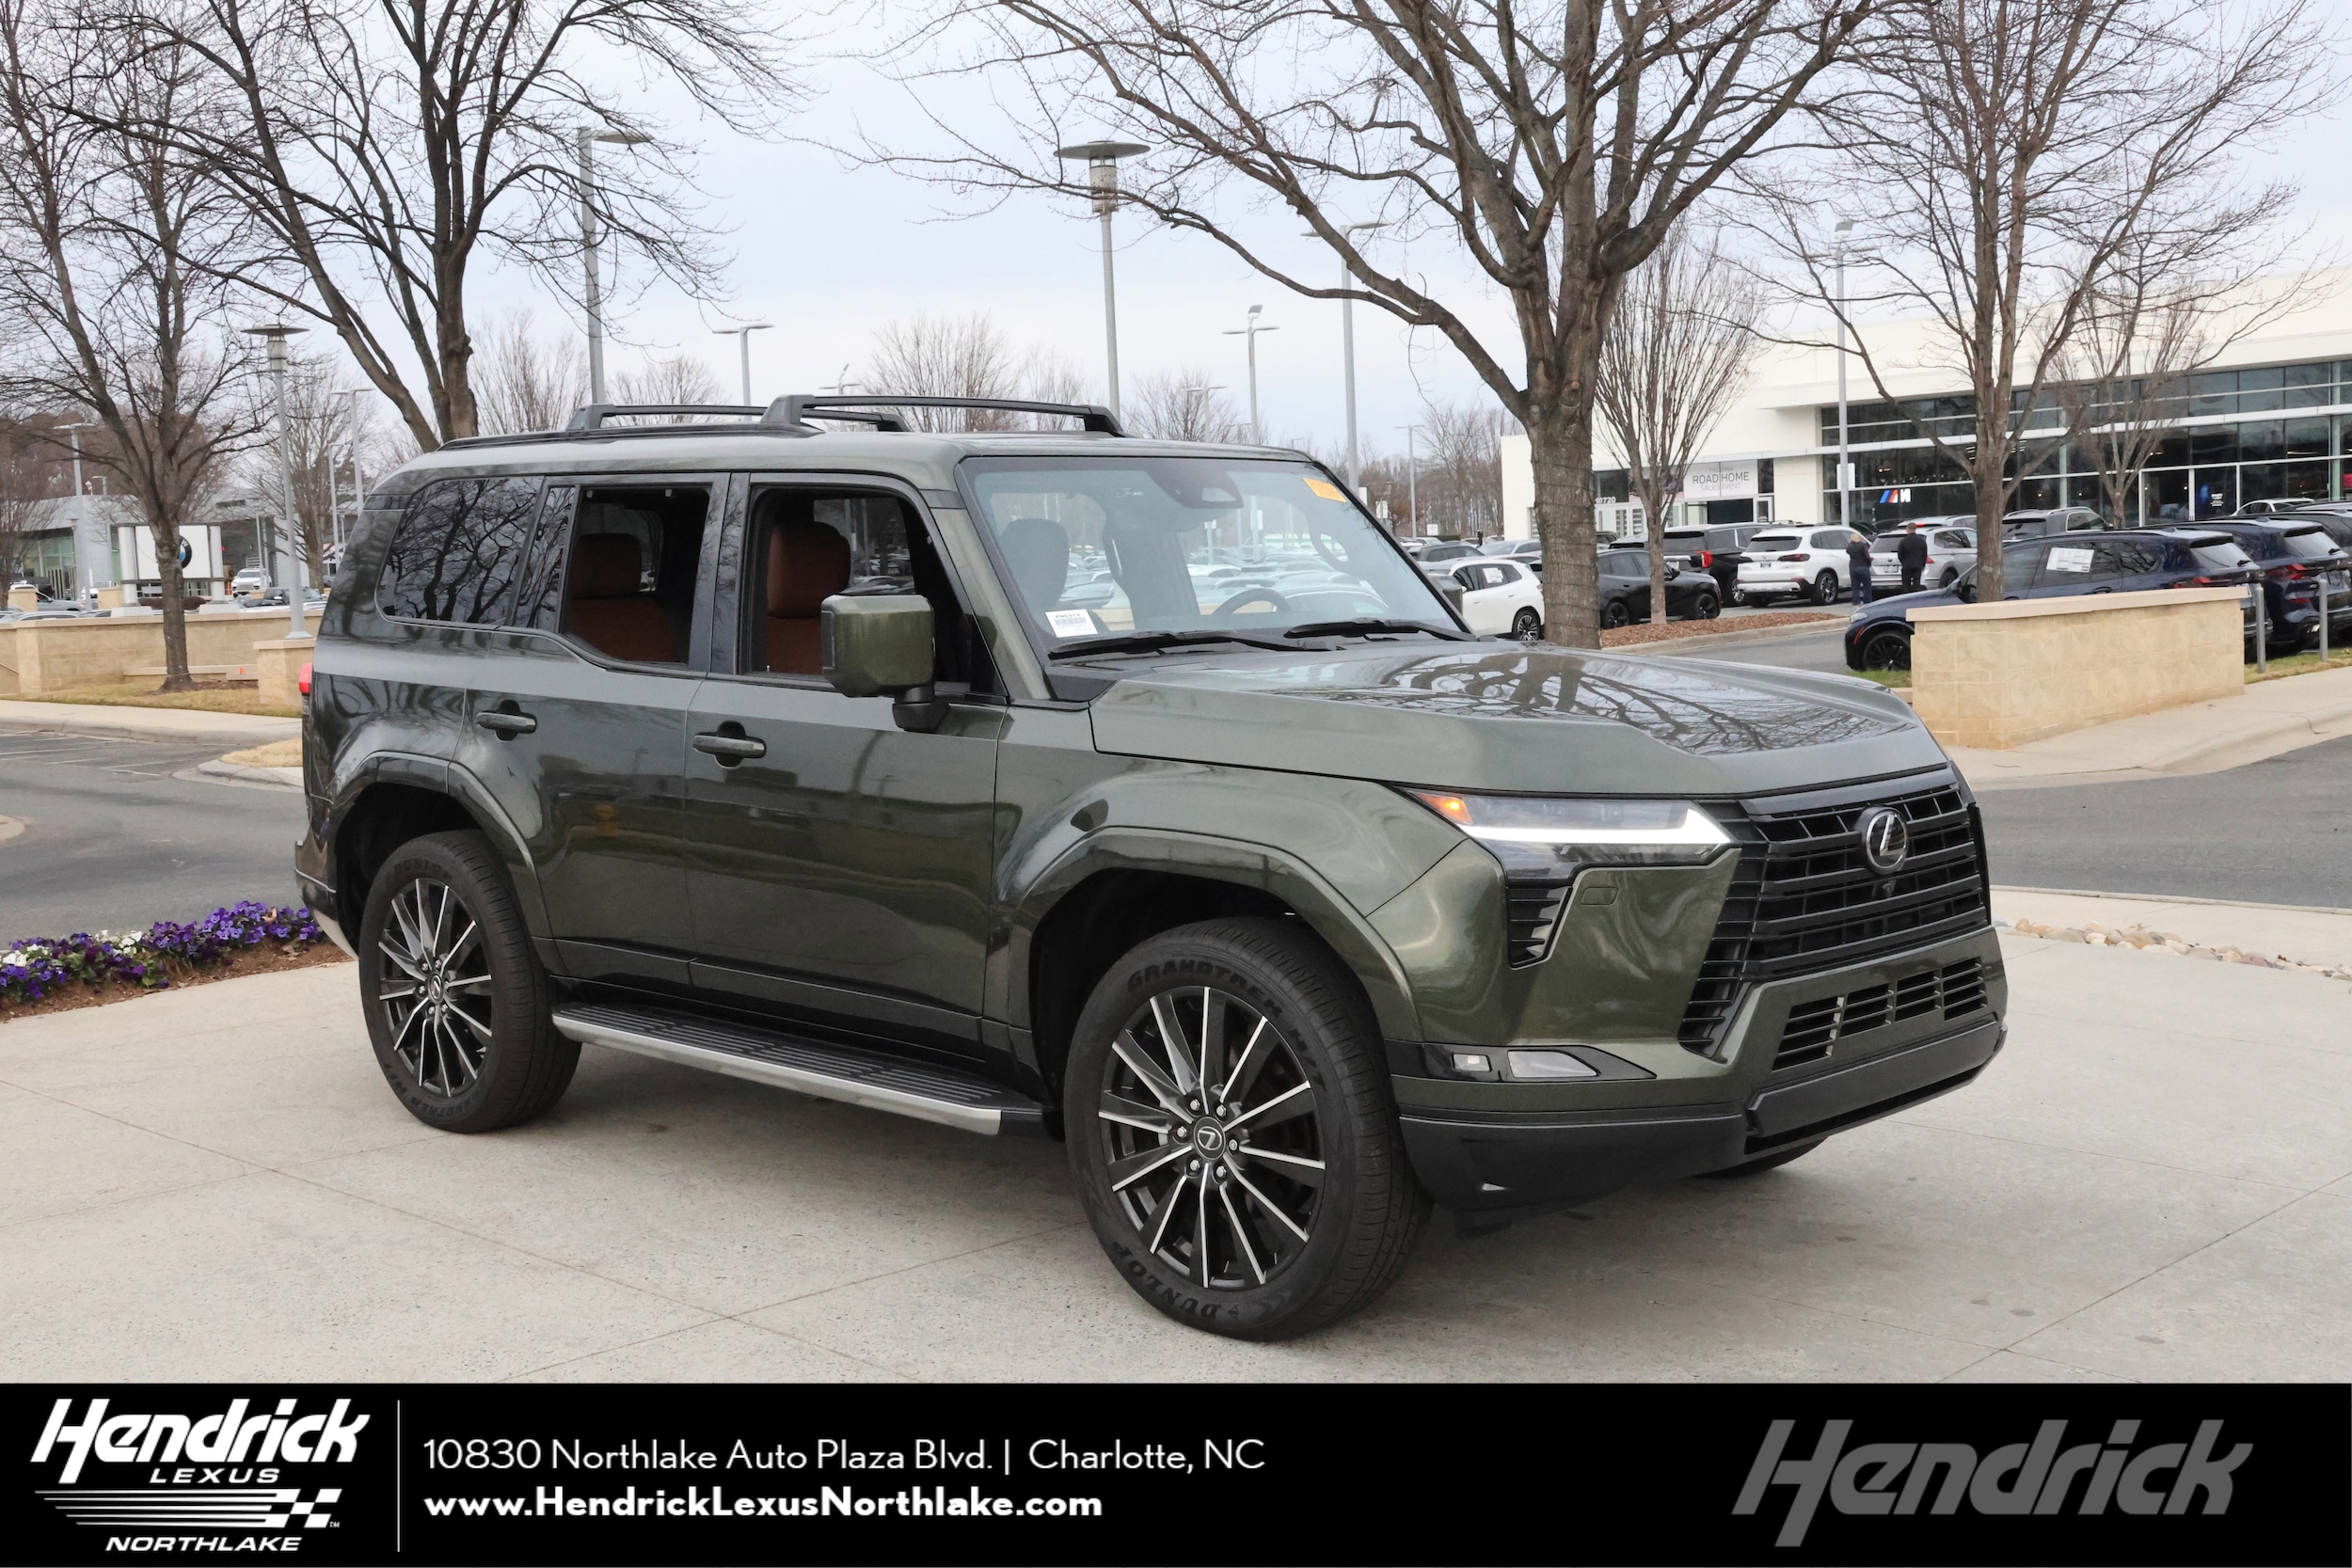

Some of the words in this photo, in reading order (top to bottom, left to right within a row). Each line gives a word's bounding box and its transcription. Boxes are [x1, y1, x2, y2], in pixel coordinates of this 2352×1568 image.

[1692, 473, 1719, 484] ROAD
[1721, 471, 1750, 483] HOME
[1700, 483, 1720, 492] SALES
[1721, 482, 1742, 490] EVENT
[1595, 496, 1616, 504] 10720
[1127, 959, 1283, 1015] GRANDTREK
[1111, 1241, 1222, 1319] DUNLOP
